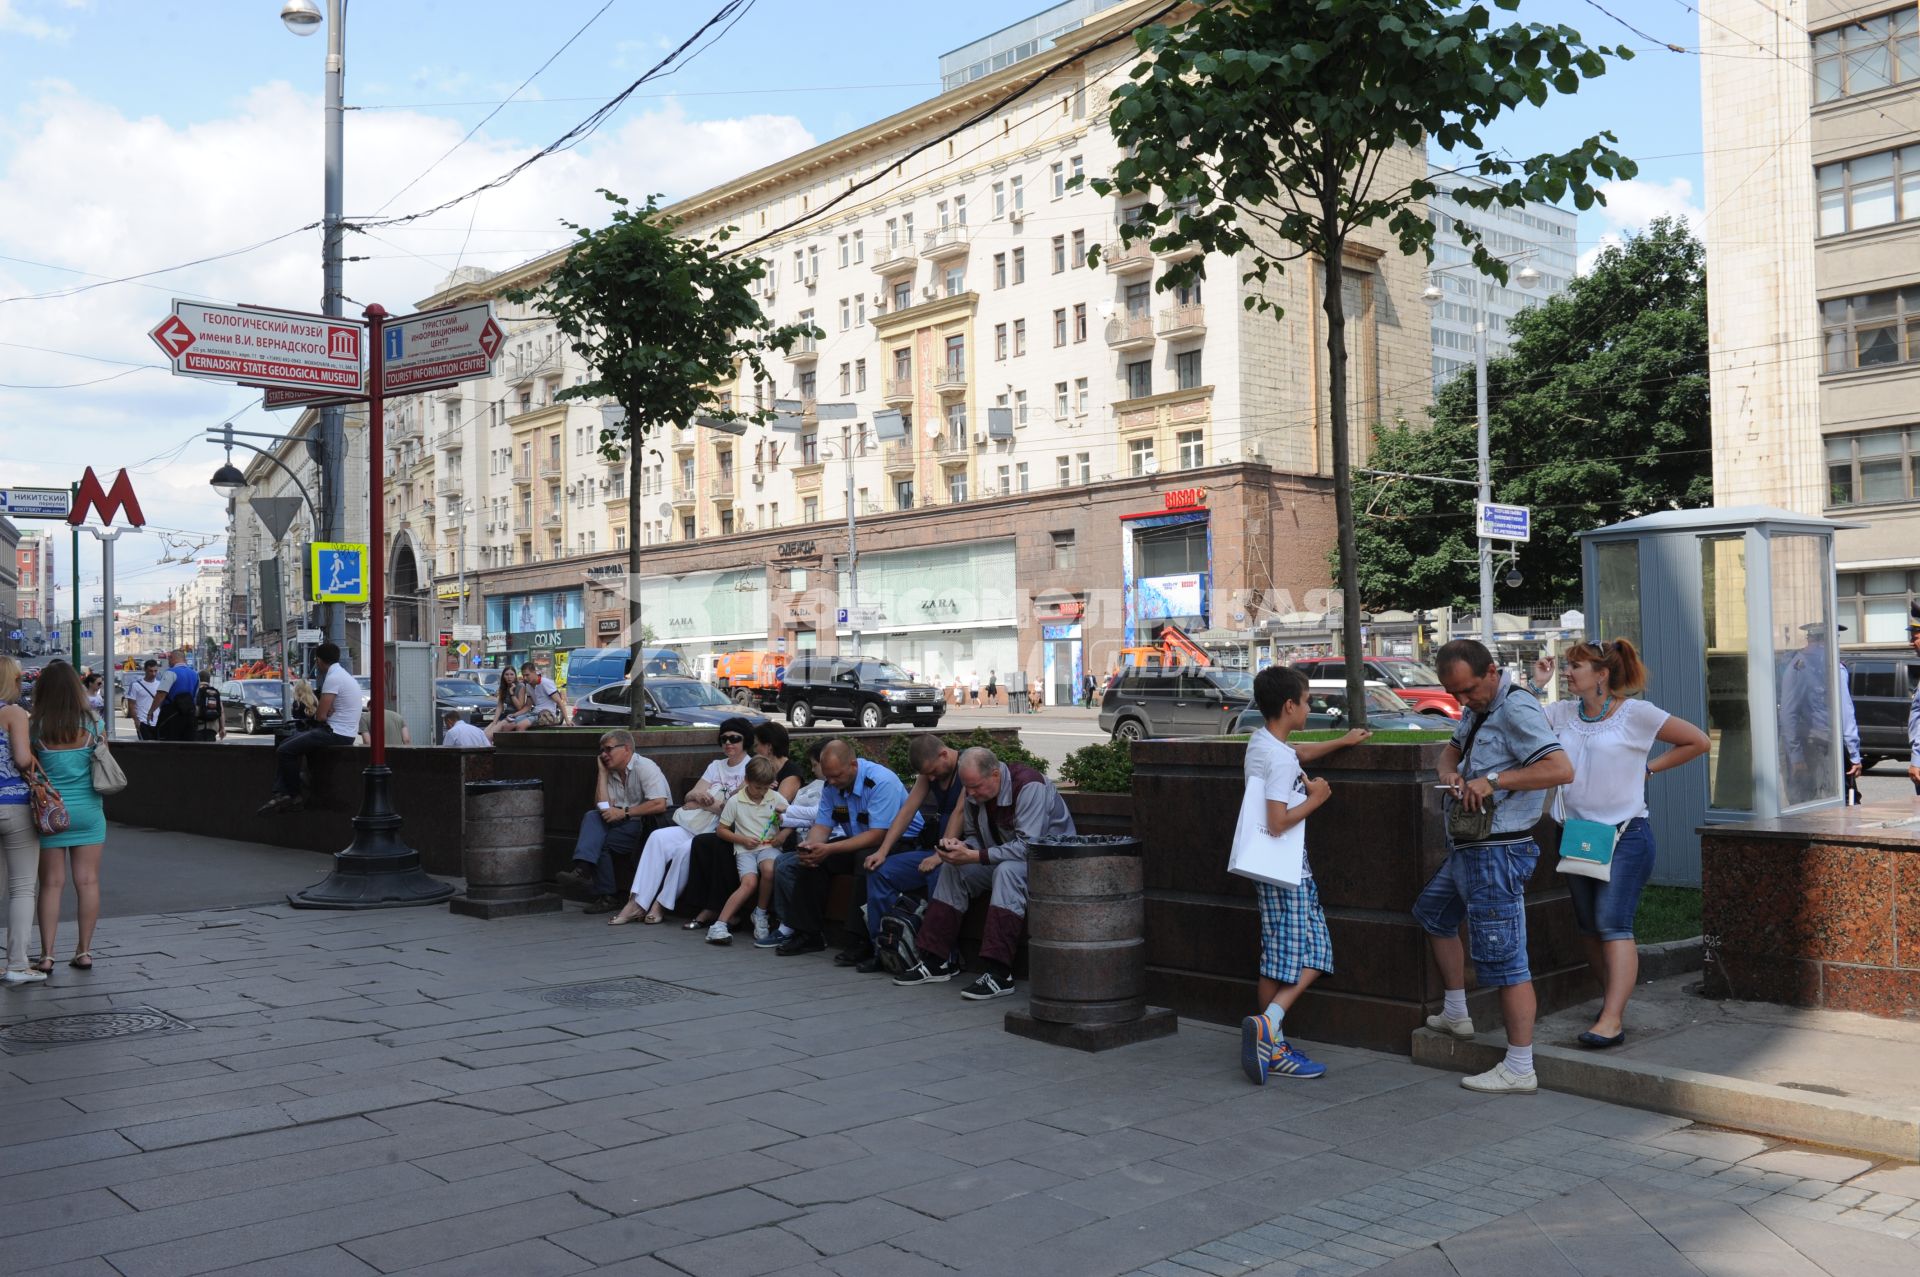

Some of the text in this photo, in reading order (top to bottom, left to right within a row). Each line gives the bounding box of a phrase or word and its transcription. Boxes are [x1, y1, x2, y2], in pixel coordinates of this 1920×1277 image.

[203, 312, 323, 338] ГЕОЛОГИЧЕСКИЙ МУЗЕЙ
[422, 315, 457, 330] ТУРИСТСКИЙ
[411, 322, 469, 342] ИНФОРМАЦИОННЫЙ
[199, 332, 326, 355] имени В.И. ВЕРНАДСКОГО
[430, 338, 449, 348] ЦЕНТР
[189, 355, 356, 384] VERNADSKY STATE GEOLOGICAL MUSEUM
[387, 371, 412, 384] TOURIST
[412, 362, 459, 379] INFORMATION
[459, 357, 485, 371] CENTRE
[268, 390, 284, 401] STATE
[14, 492, 66, 502] НИКИТСКИЙ
[1164, 488, 1197, 508] BOSCO
[777, 541, 816, 556] ОДЕЖДА
[921, 598, 956, 610] ZARA
[668, 617, 693, 626] ZARA
[534, 632, 562, 646] COLIN'S
